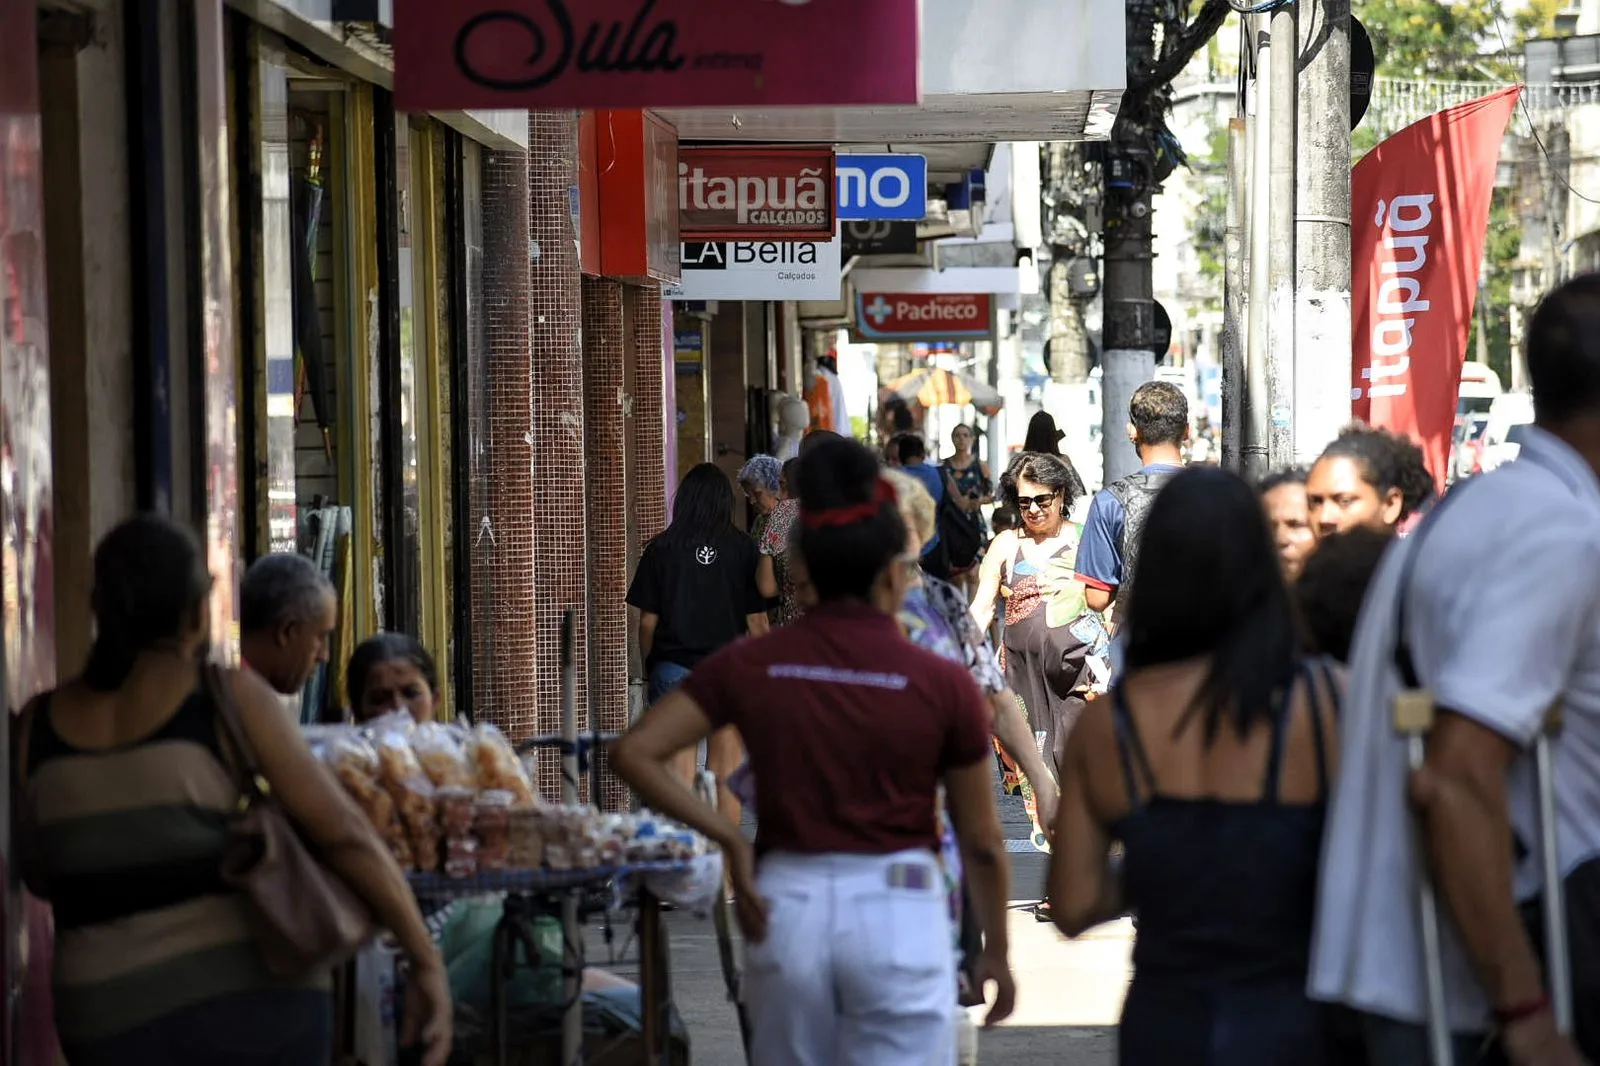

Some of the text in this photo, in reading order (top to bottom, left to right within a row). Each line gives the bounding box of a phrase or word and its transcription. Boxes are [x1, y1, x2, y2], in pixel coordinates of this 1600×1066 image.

[678, 162, 826, 225] itapuã
[749, 210, 825, 226] CALÇADOS
[680, 242, 724, 264] LA
[777, 272, 816, 281] Calçados
[1351, 193, 1435, 400] itapuã
[896, 301, 978, 321] Pacheco
